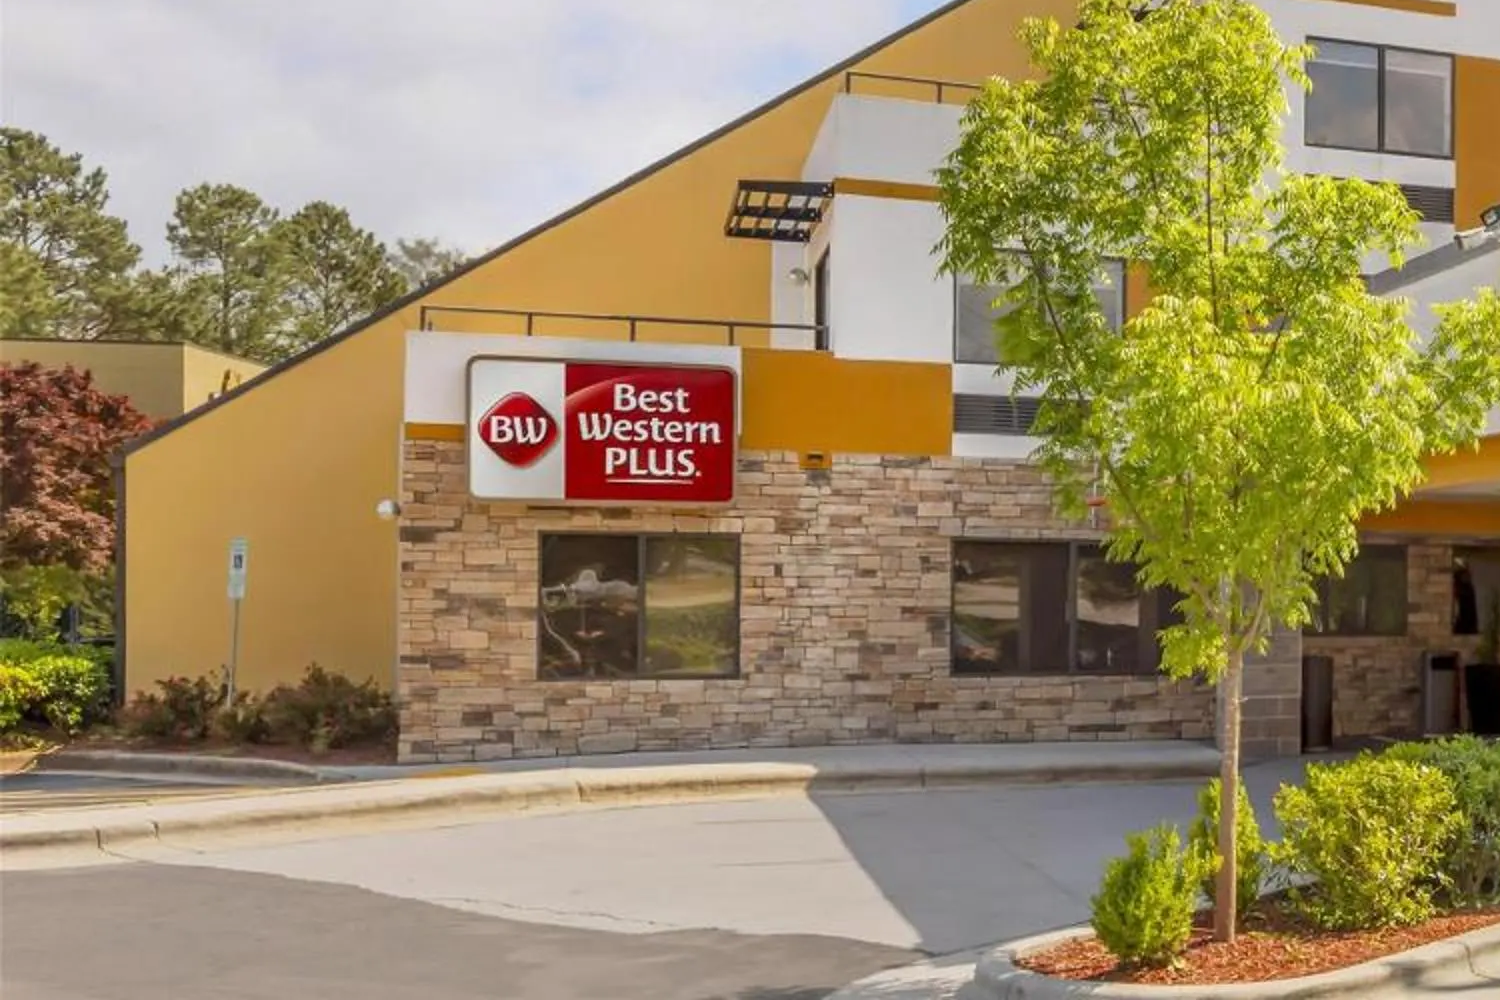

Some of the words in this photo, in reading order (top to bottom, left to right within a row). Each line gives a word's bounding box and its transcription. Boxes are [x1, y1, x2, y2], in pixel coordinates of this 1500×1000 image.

[613, 383, 691, 413] Best
[489, 415, 547, 444] BW
[577, 411, 721, 444] Western
